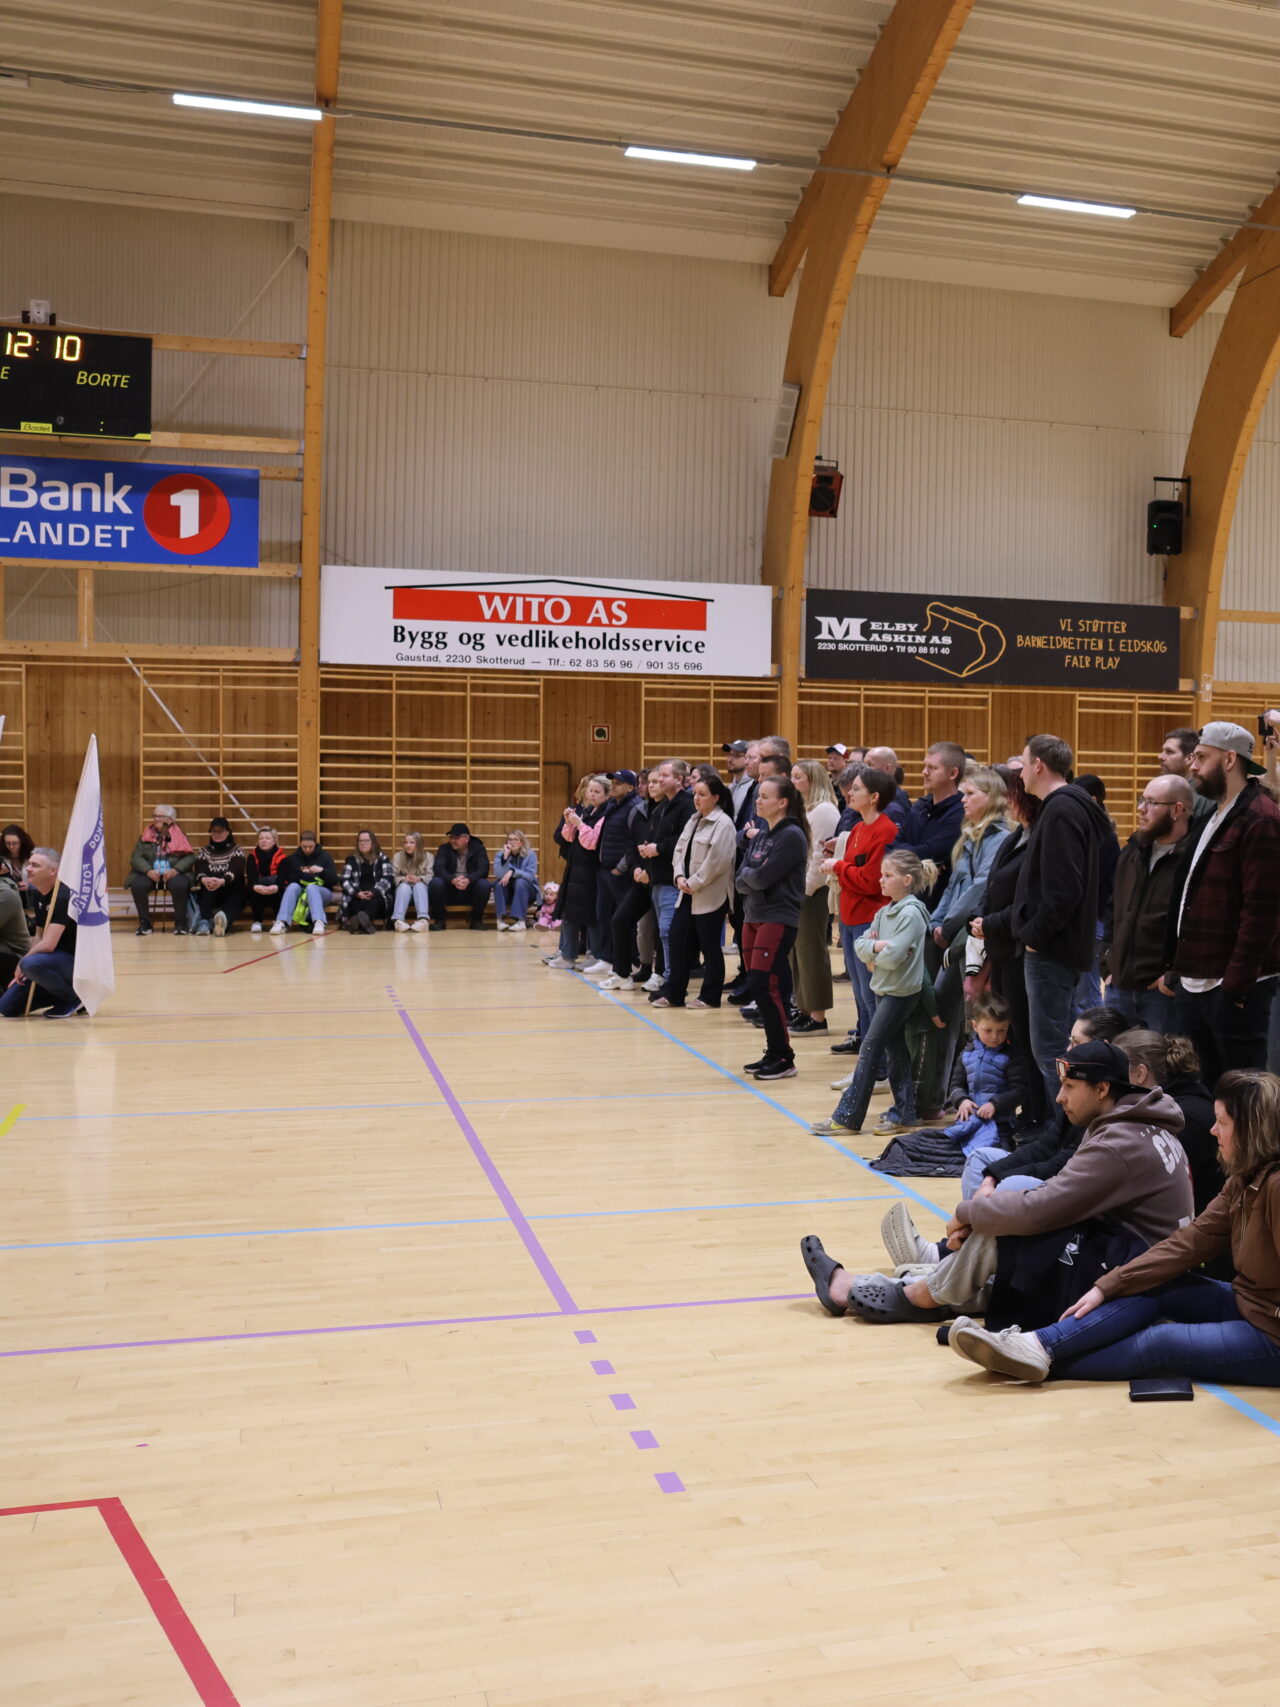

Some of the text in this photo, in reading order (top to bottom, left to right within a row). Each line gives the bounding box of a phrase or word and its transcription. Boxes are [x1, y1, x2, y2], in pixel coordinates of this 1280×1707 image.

[76, 370, 131, 388] BORTE
[0, 466, 200, 539] Bank 1
[478, 594, 629, 626] WITO AS
[1059, 618, 1127, 634] VI STØTTER
[392, 624, 706, 654] Bygg og vedlikeholdsservice
[929, 635, 953, 645] AS
[1016, 635, 1168, 653] BARNEIDRETTEN I EIDSKOG
[817, 642, 836, 650] 2230
[838, 643, 888, 652] SKOTTERUD
[940, 647, 950, 655] 40
[395, 652, 442, 663] Gaustad,
[445, 654, 472, 664] 2230
[475, 655, 526, 666] Skotterud
[569, 658, 582, 667] 62
[586, 659, 599, 668] 83
[603, 660, 616, 669] 56
[620, 660, 633, 669] 96
[646, 661, 664, 670] 901
[667, 661, 680, 671] 35
[683, 661, 703, 671] 696
[1064, 655, 1121, 670] FAIR PLAY
